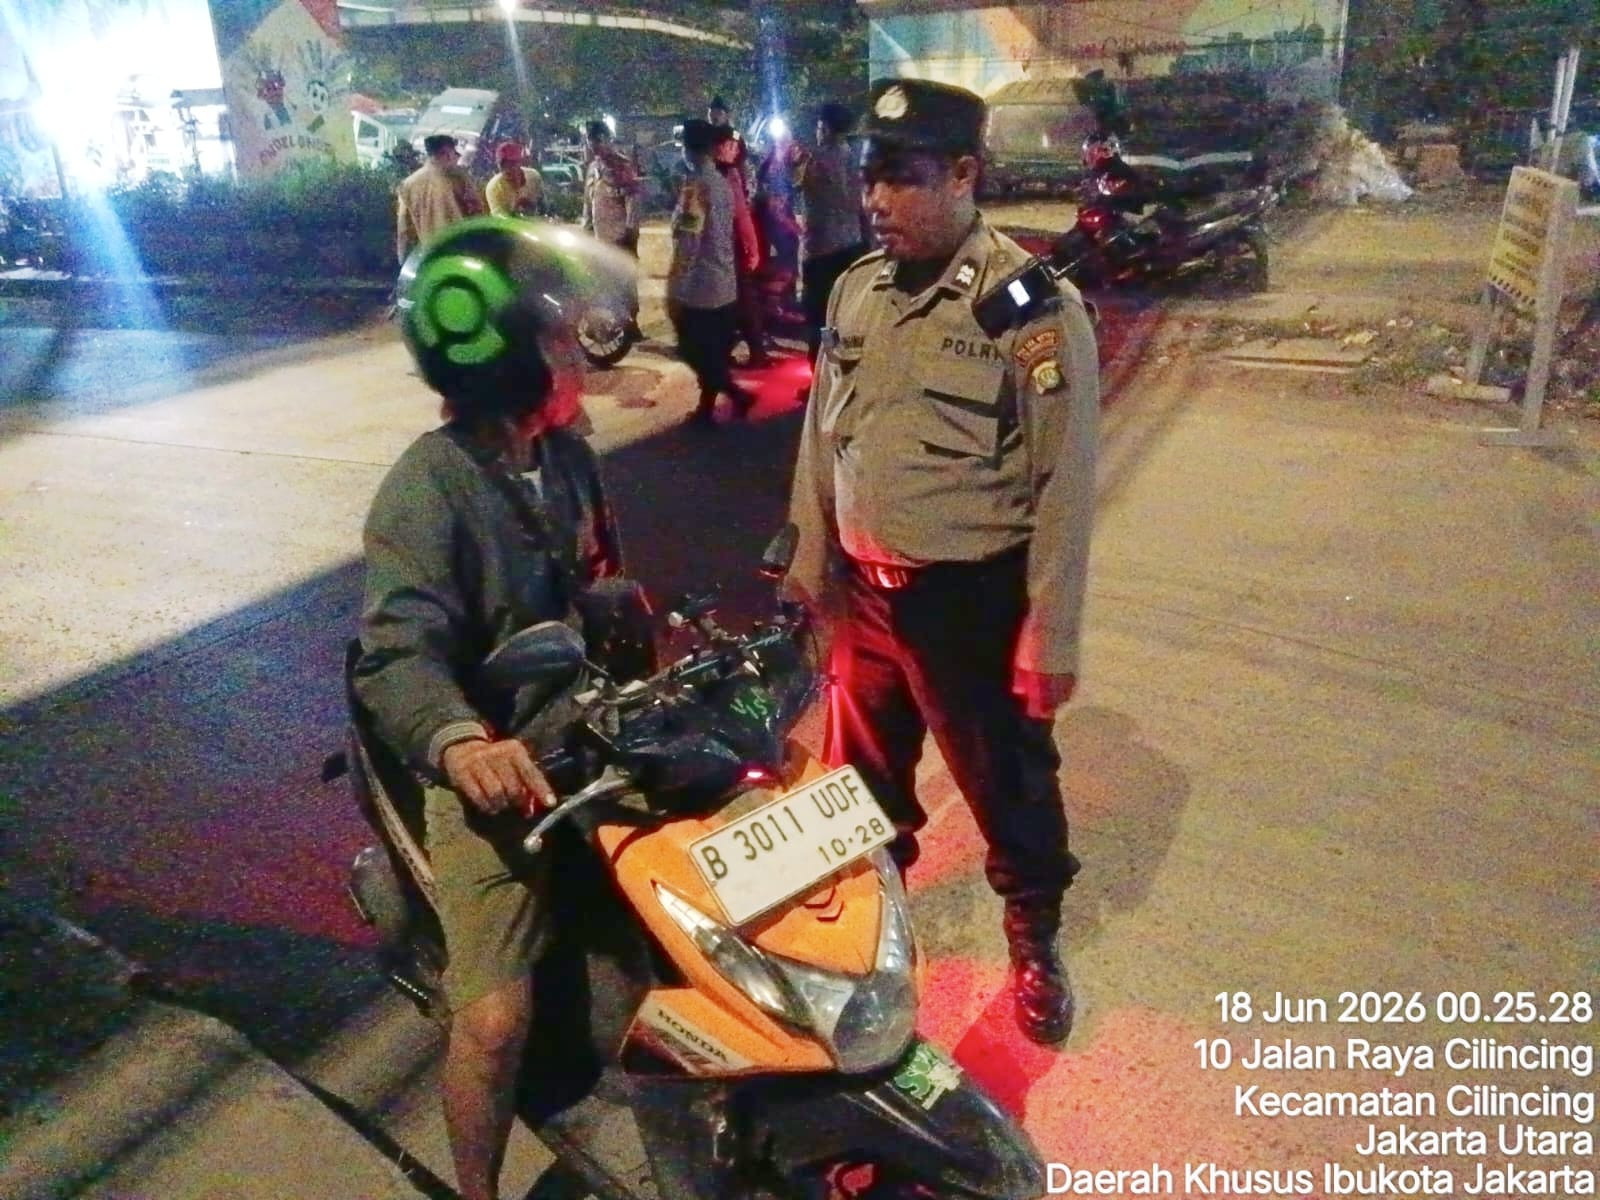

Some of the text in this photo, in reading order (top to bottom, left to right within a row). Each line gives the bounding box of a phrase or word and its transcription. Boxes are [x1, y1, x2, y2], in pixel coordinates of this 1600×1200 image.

[941, 338, 1001, 361] POLRI
[701, 775, 861, 880] B 3011 UDF
[657, 1008, 728, 1063] HONDA
